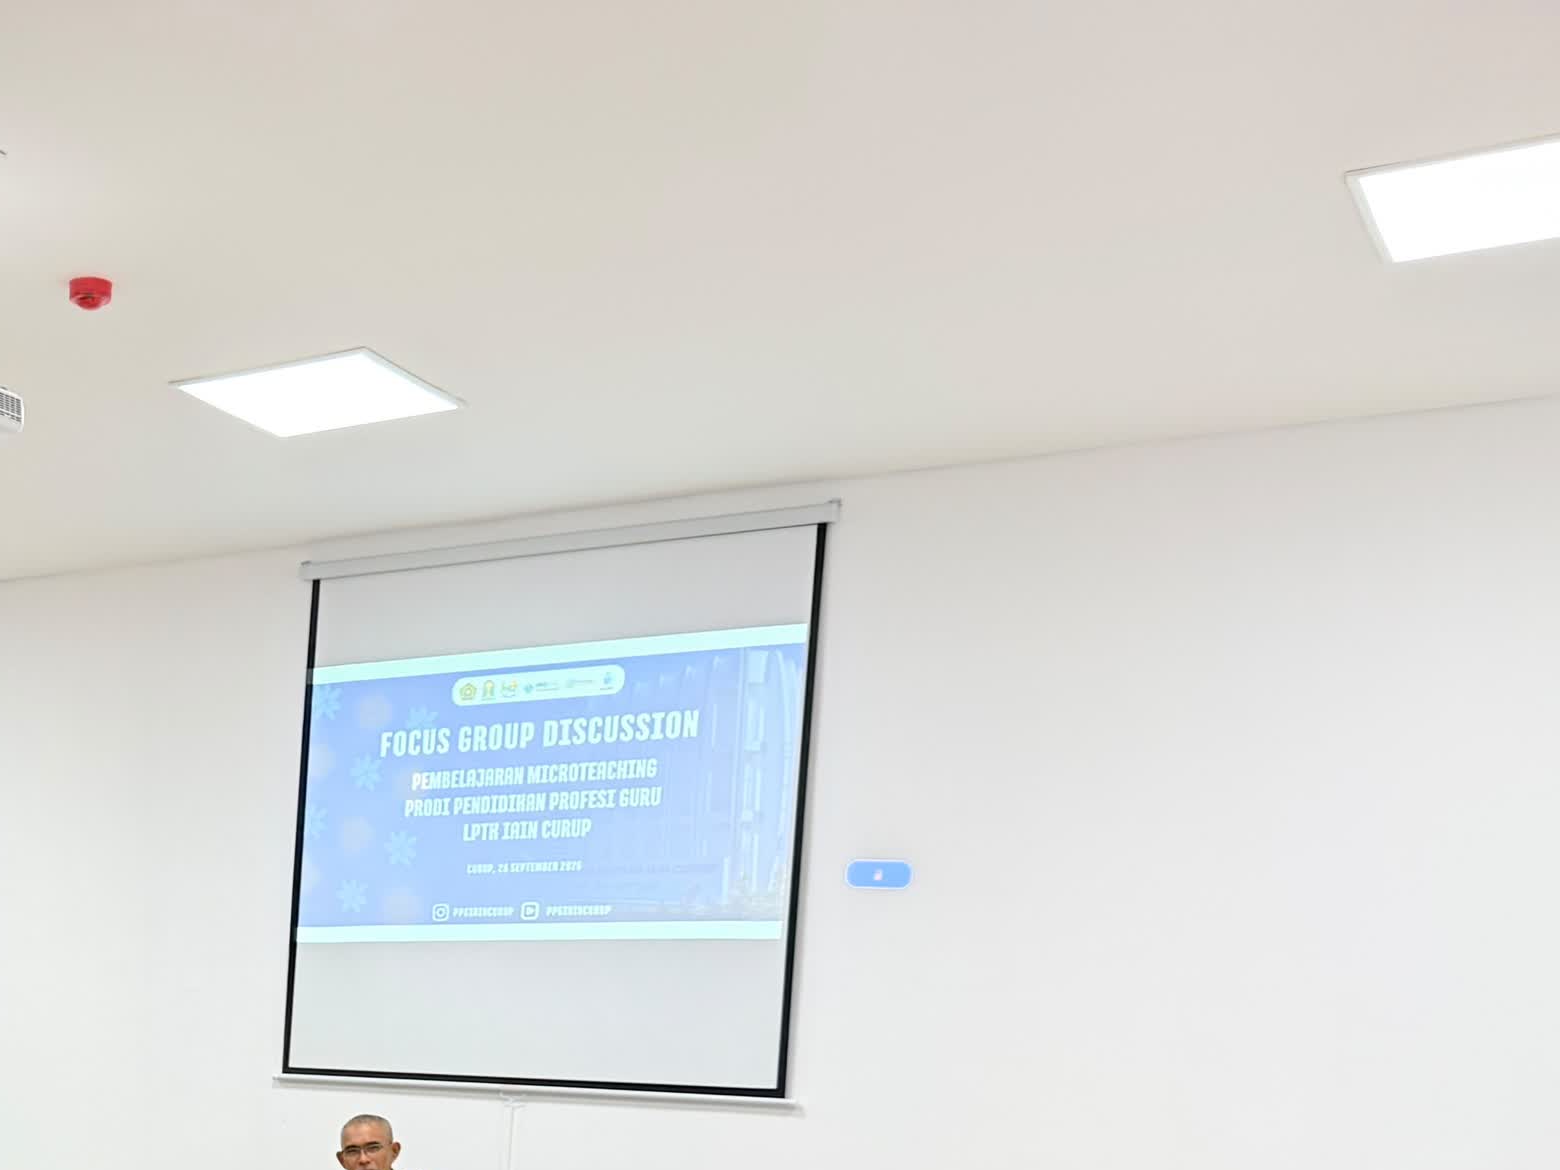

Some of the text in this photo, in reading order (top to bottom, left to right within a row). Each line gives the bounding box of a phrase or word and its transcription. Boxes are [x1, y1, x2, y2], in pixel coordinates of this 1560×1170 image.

[380, 710, 699, 757] FOCUS GROUP DISCUSSION
[411, 758, 657, 791] PEMBELAJARAN MICROTEACHING
[404, 786, 662, 817] PRODI PENDIDIKAN PROFESI GURU
[501, 820, 537, 840] IAIN
[541, 818, 591, 840] CURUP
